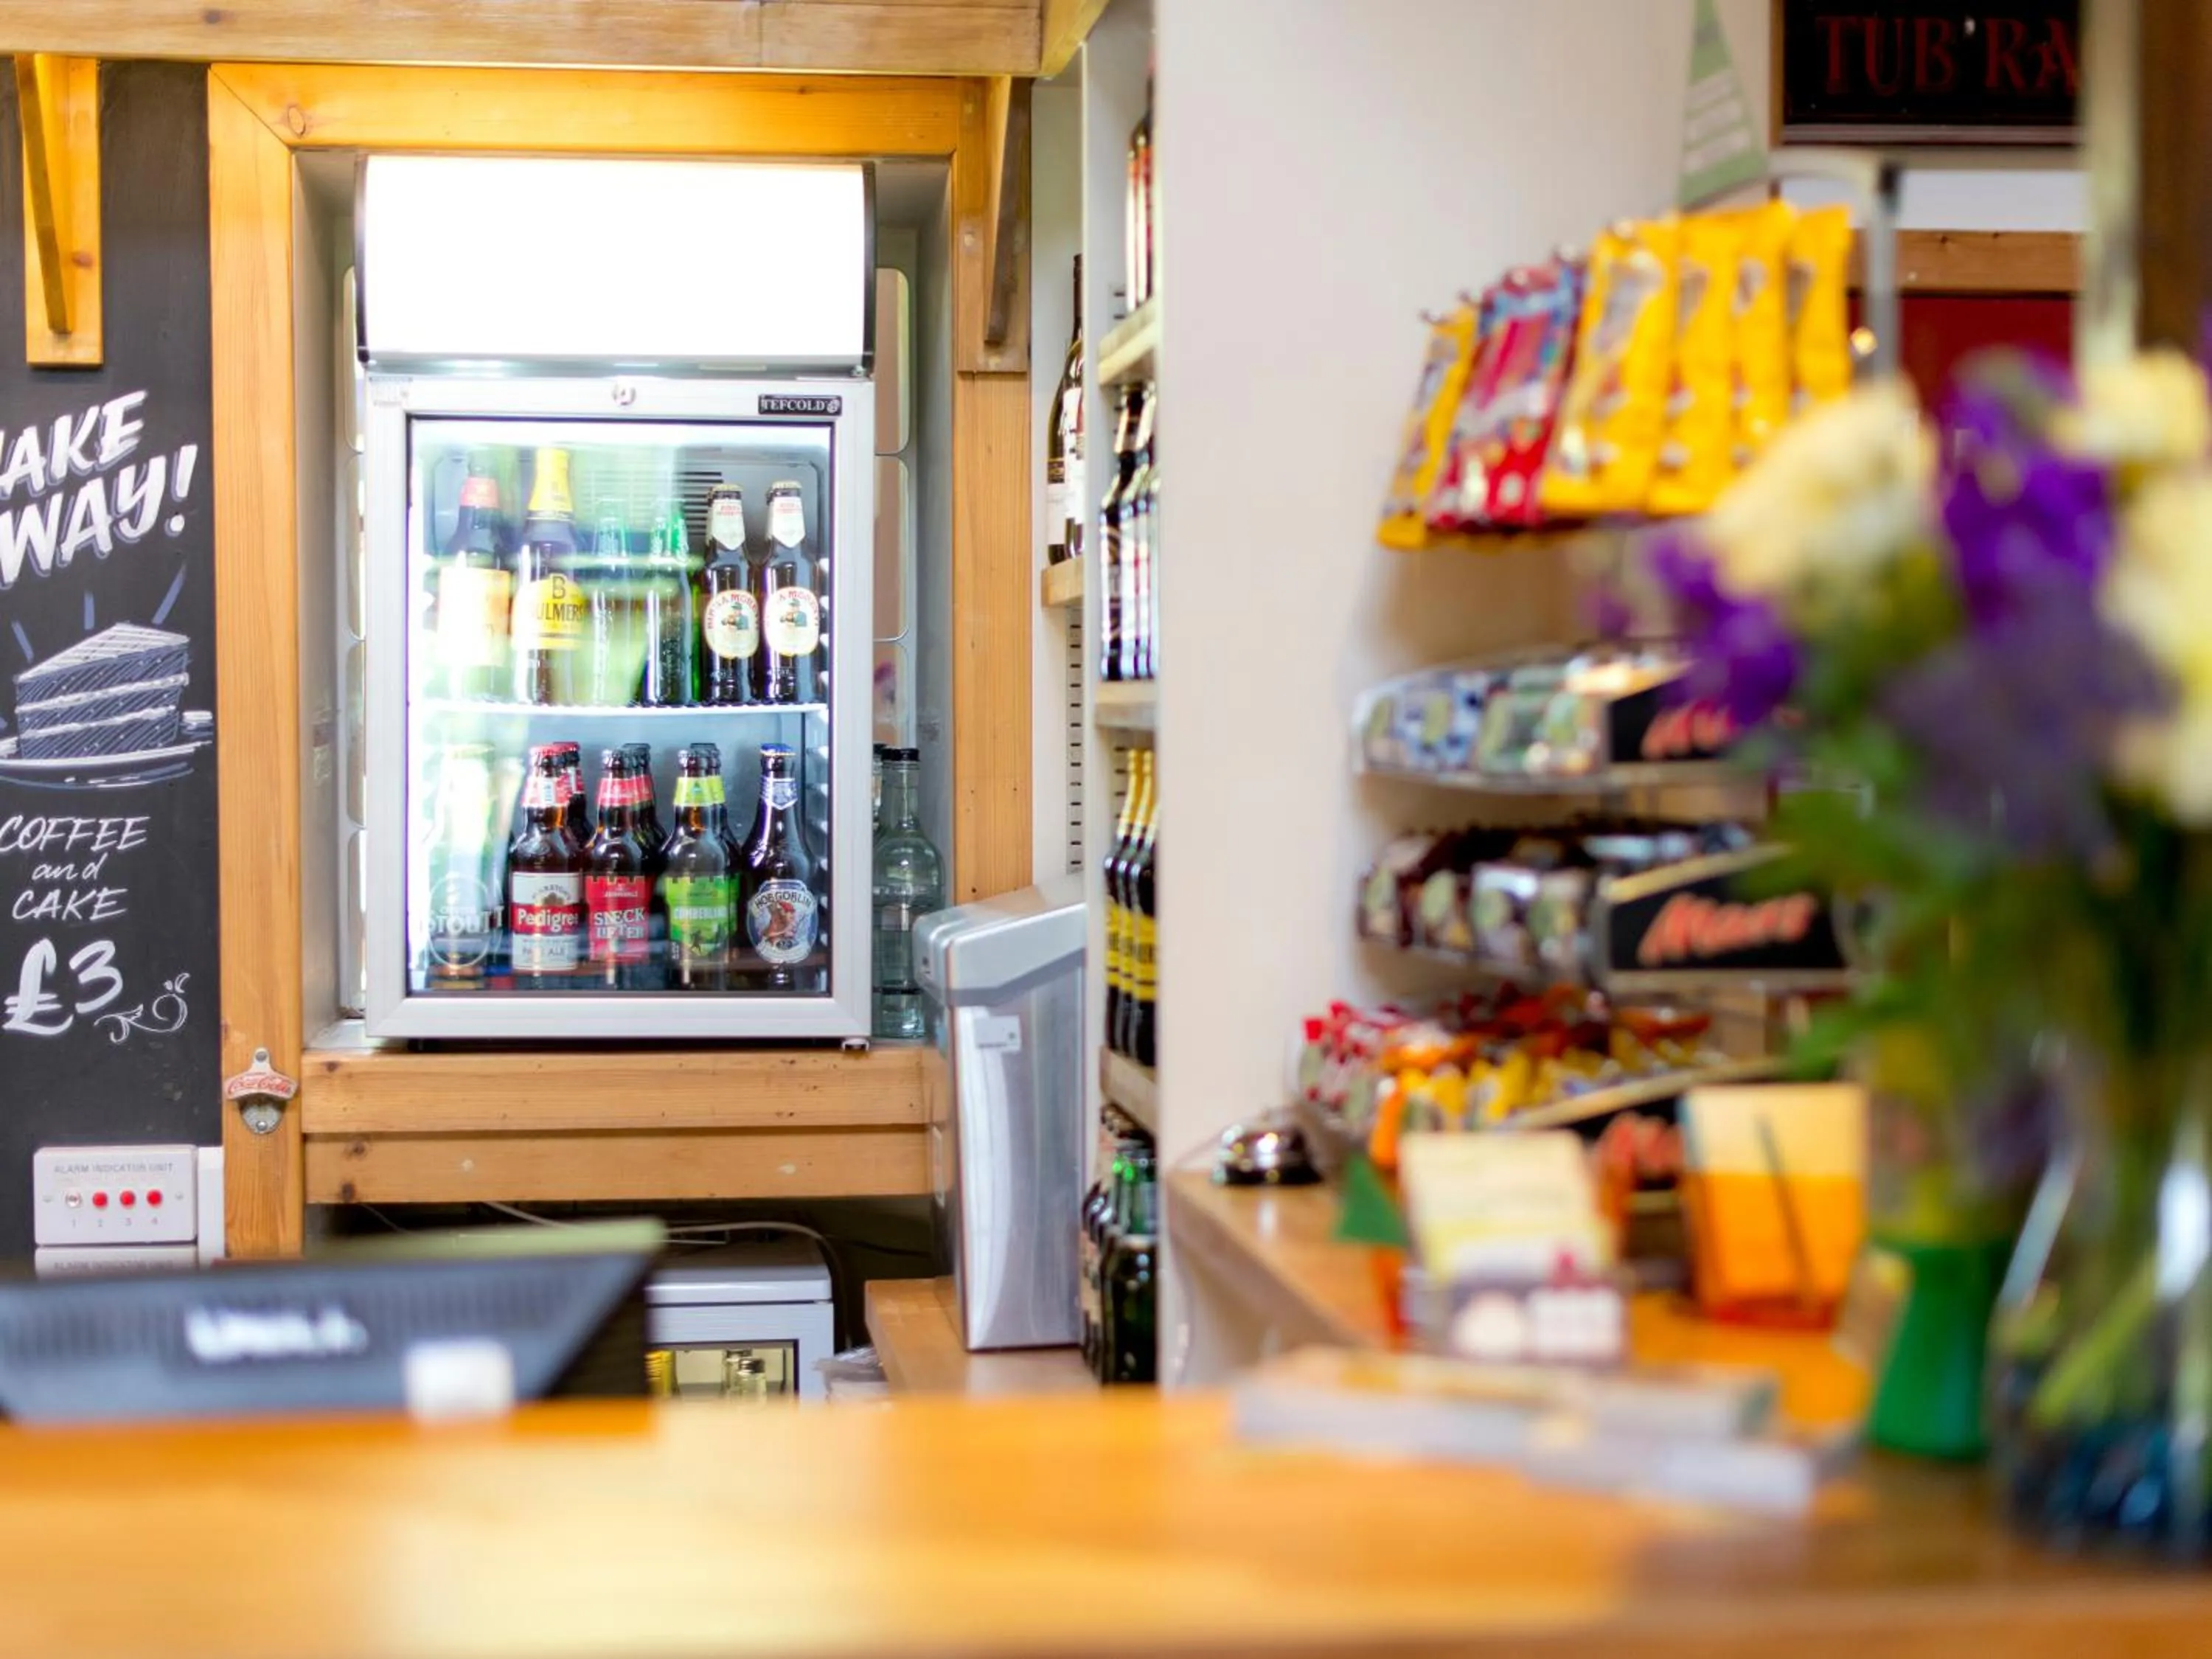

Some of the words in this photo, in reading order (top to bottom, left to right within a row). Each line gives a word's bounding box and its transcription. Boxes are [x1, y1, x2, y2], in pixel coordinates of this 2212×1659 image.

[762, 399, 825, 411] TEFCOLD
[0, 390, 147, 498] AKE
[0, 815, 150, 851] COFFEE
[32, 852, 108, 880] and
[12, 887, 128, 920] CAKE
[594, 908, 644, 925] SNECK
[2, 938, 123, 1035] £3
[54, 1165, 89, 1174] ALARM
[149, 1163, 173, 1172] UNIT
